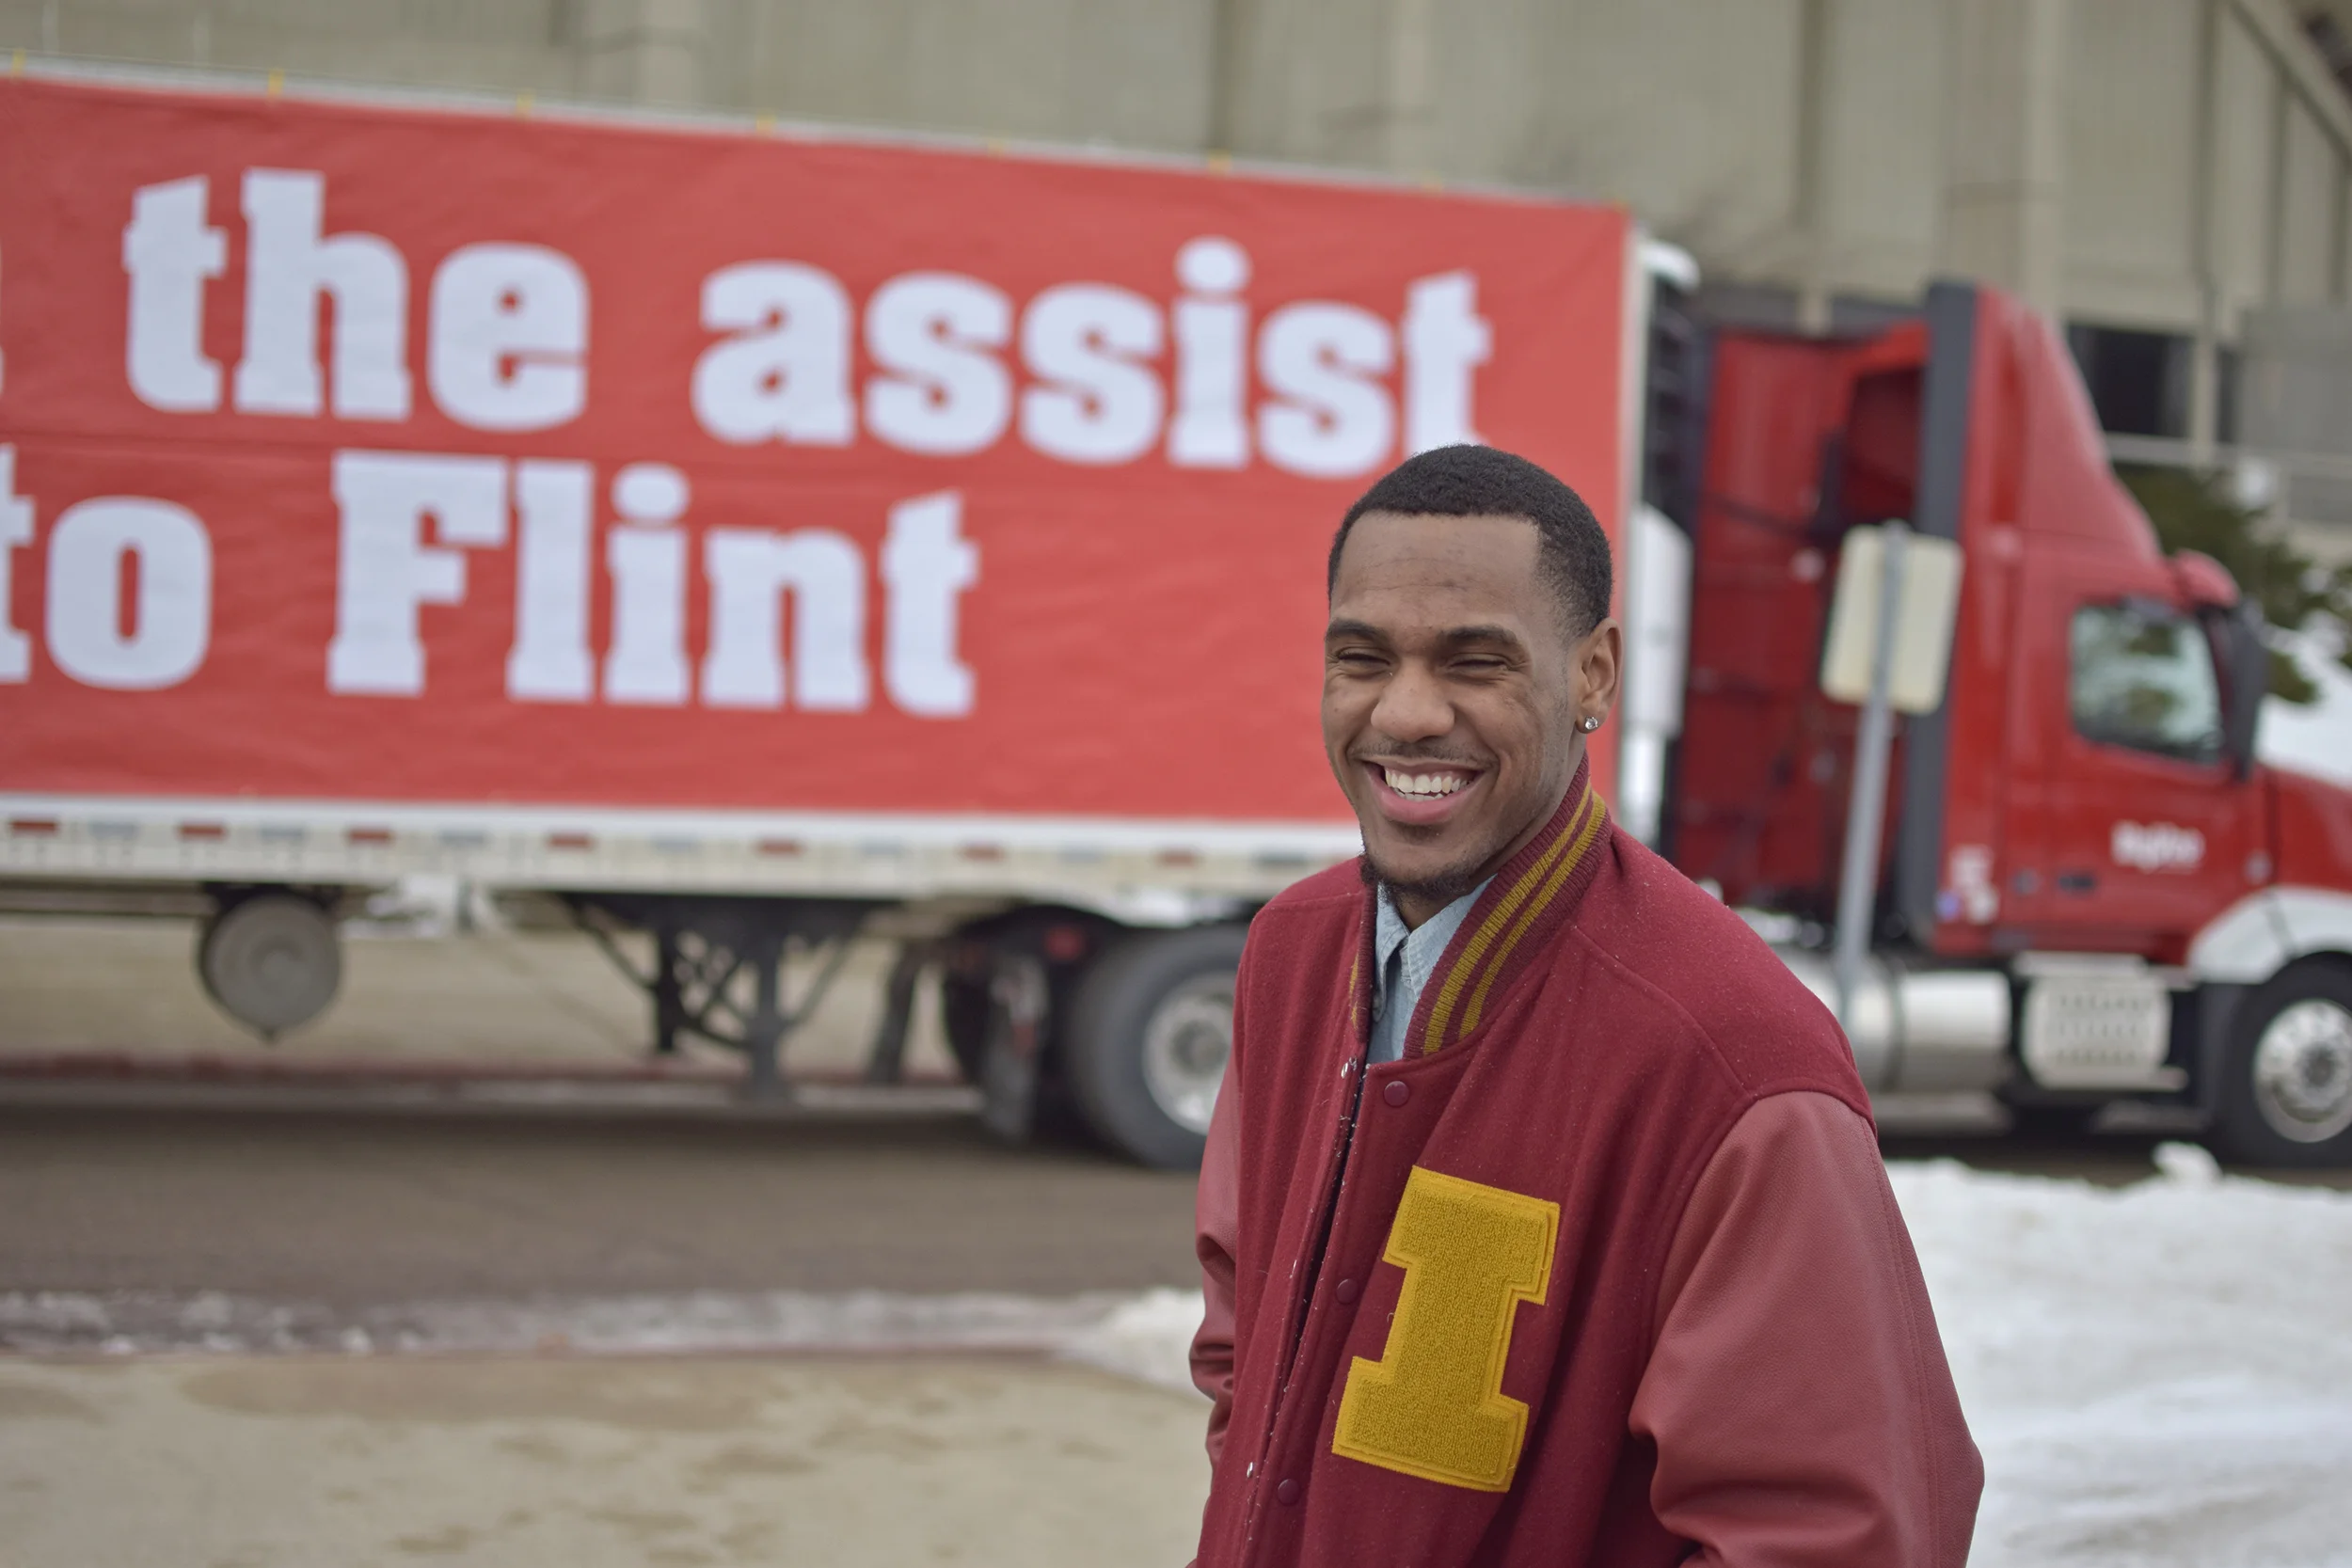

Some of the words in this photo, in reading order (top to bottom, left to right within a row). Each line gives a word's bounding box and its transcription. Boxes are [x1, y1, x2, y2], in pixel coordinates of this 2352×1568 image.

[124, 169, 588, 430] the
[692, 238, 1492, 477] assist
[326, 451, 978, 715] Flint
[1332, 1165, 1561, 1493] I
